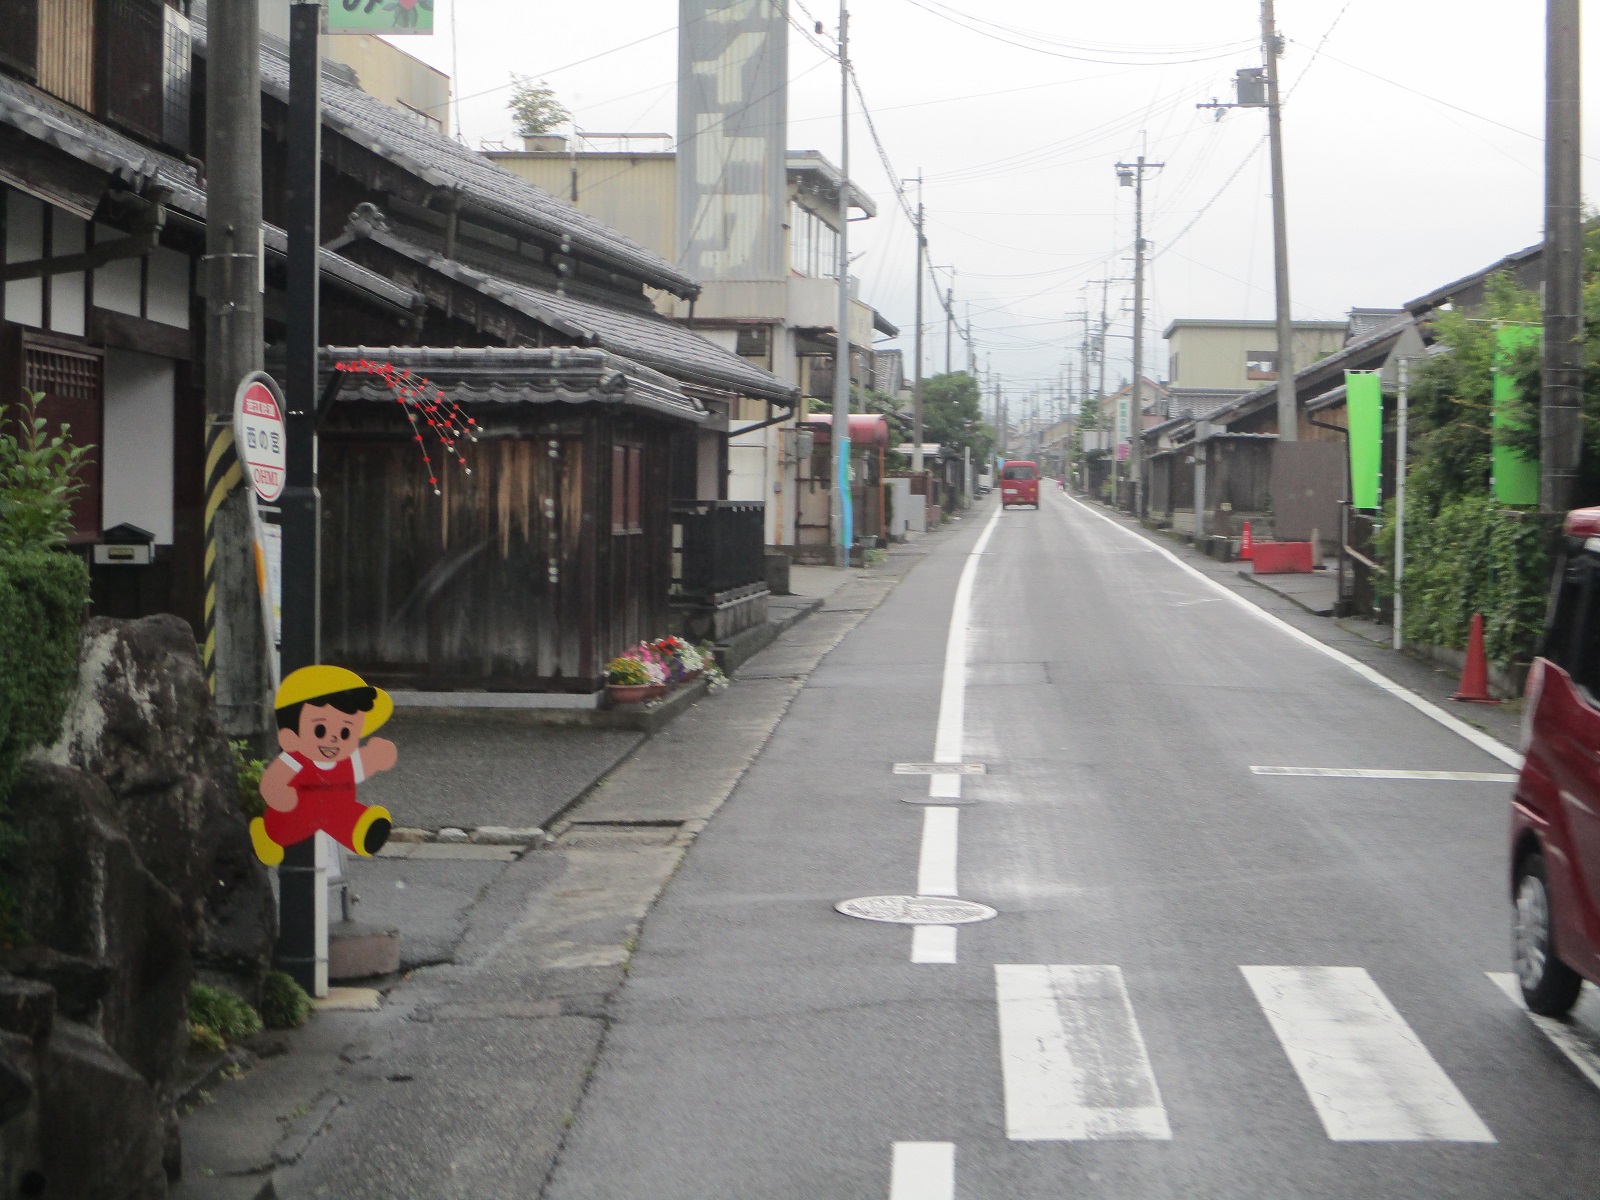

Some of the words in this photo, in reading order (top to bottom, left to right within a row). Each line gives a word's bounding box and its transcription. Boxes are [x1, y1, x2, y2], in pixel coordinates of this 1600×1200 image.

[247, 427, 280, 453] 西の宮
[255, 469, 279, 486] OHMI
